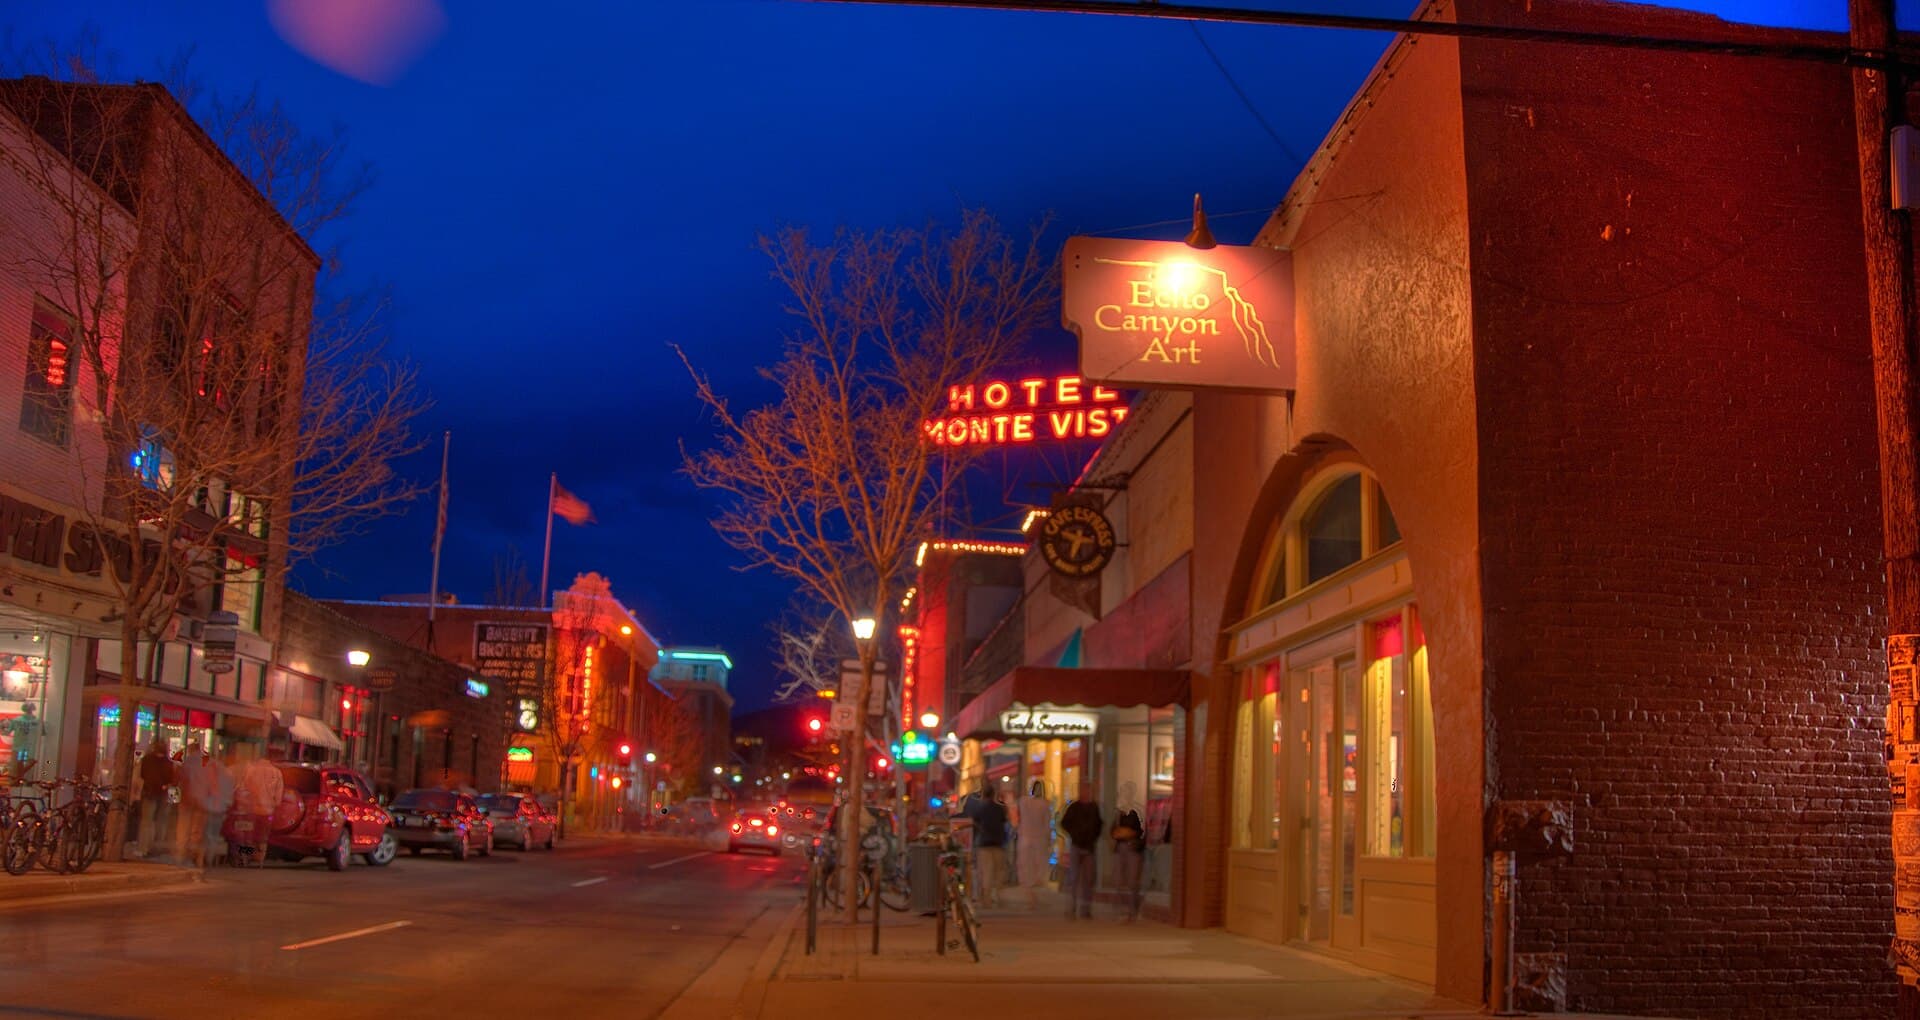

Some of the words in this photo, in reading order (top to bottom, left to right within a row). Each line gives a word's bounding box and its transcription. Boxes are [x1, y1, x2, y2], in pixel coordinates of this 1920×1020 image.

[1127, 279, 1210, 310] Echo
[1094, 304, 1220, 344] Canyon
[1139, 336, 1202, 364] Art
[950, 376, 1118, 411] HOTEL
[921, 412, 1034, 445] MONTE
